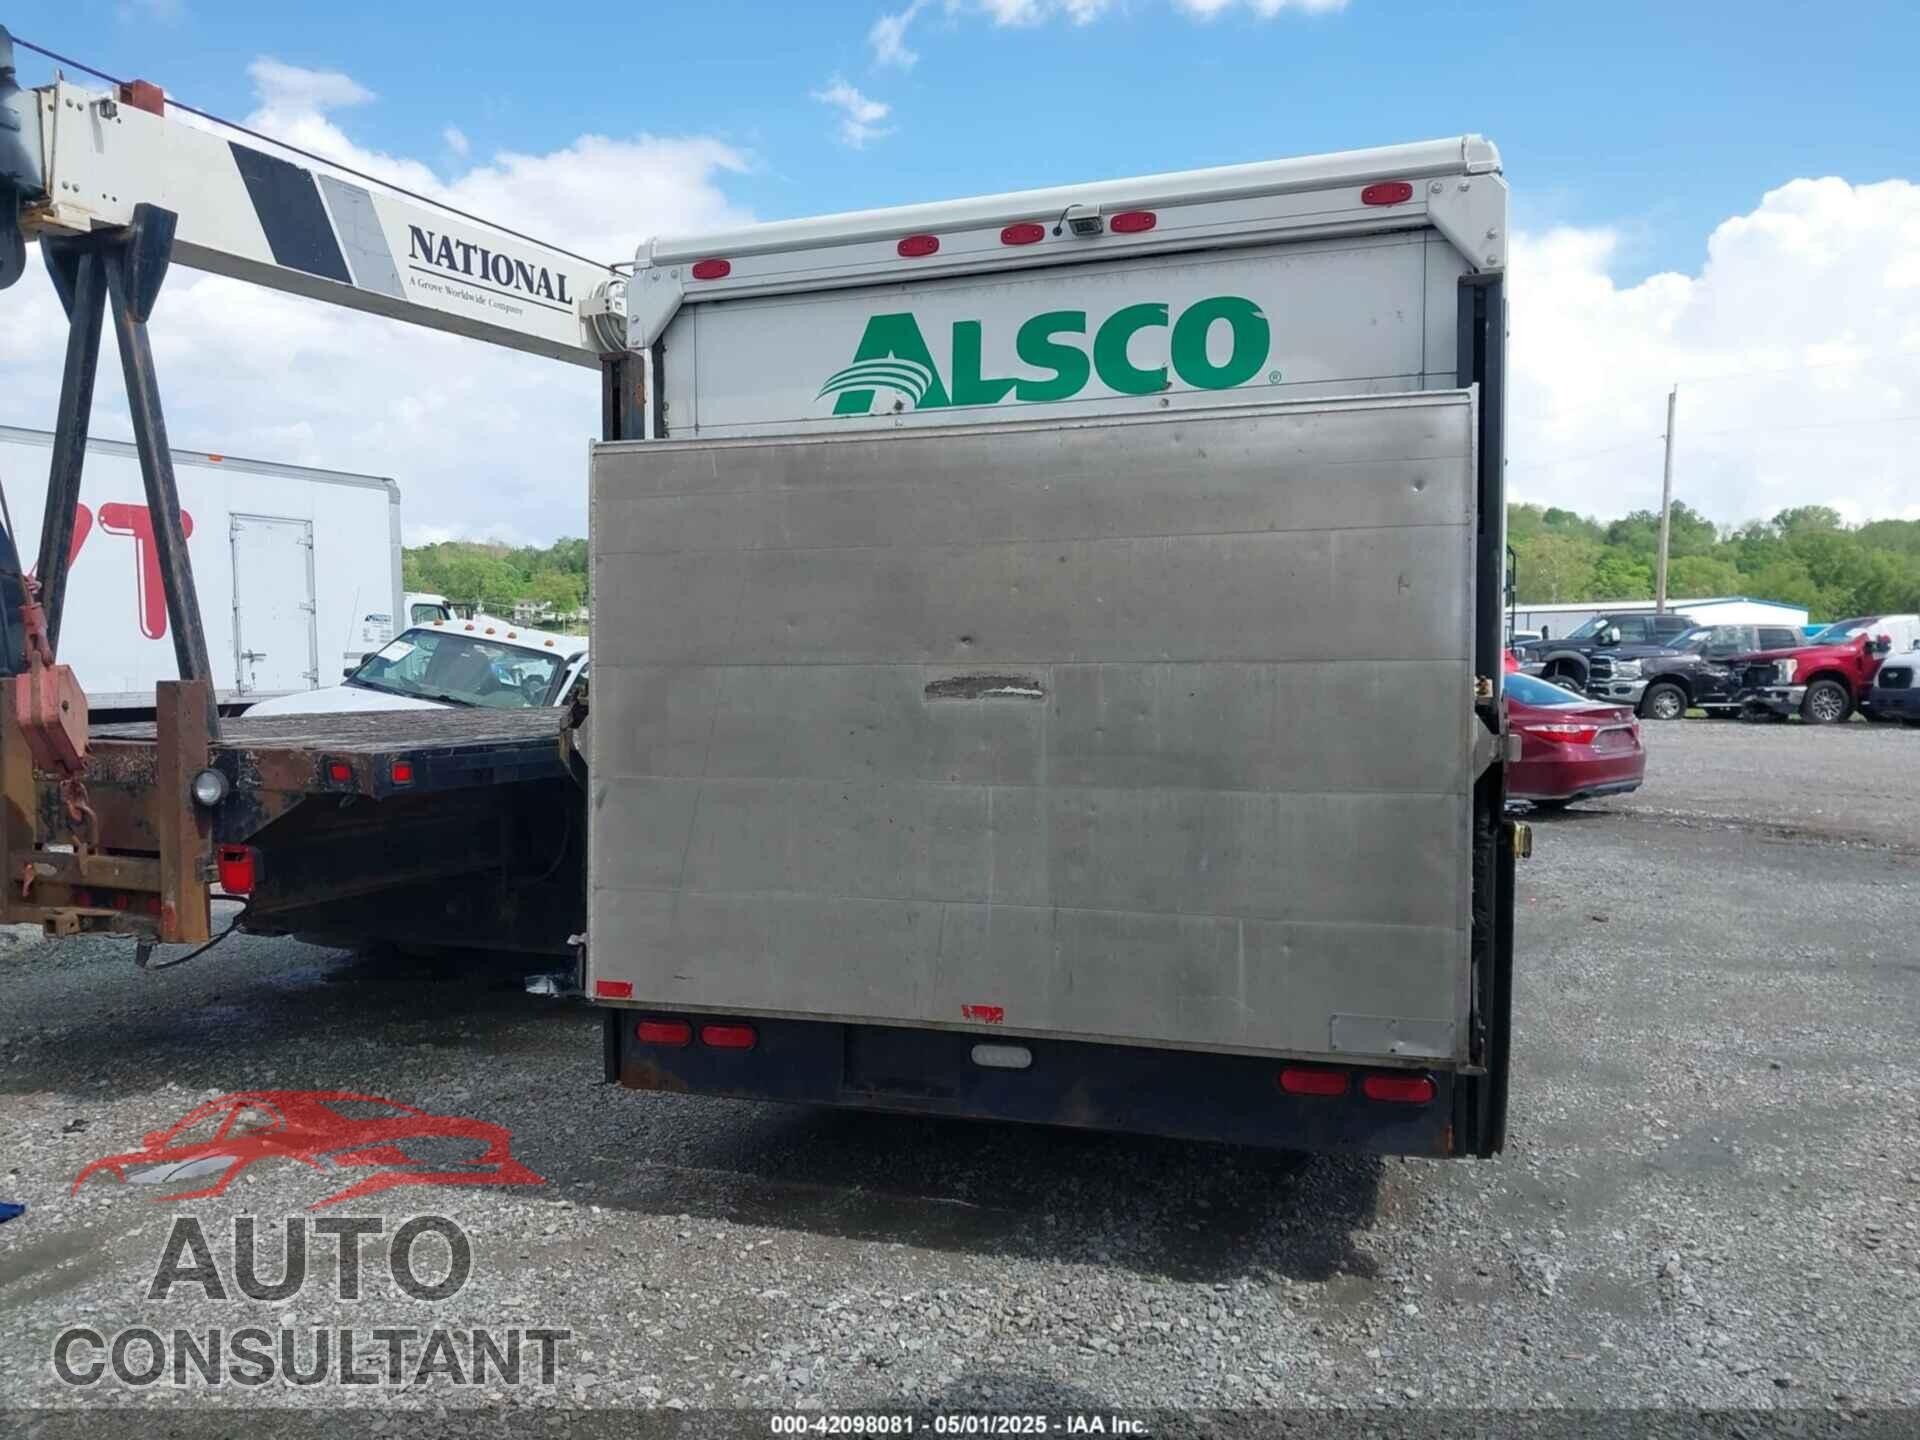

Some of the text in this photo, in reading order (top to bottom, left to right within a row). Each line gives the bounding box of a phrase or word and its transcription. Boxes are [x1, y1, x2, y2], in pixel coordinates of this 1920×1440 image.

[408, 224, 573, 305] NATIONAL
[409, 276, 524, 316] A Grove Worldwide Company
[815, 296, 1271, 417] ALSCO
